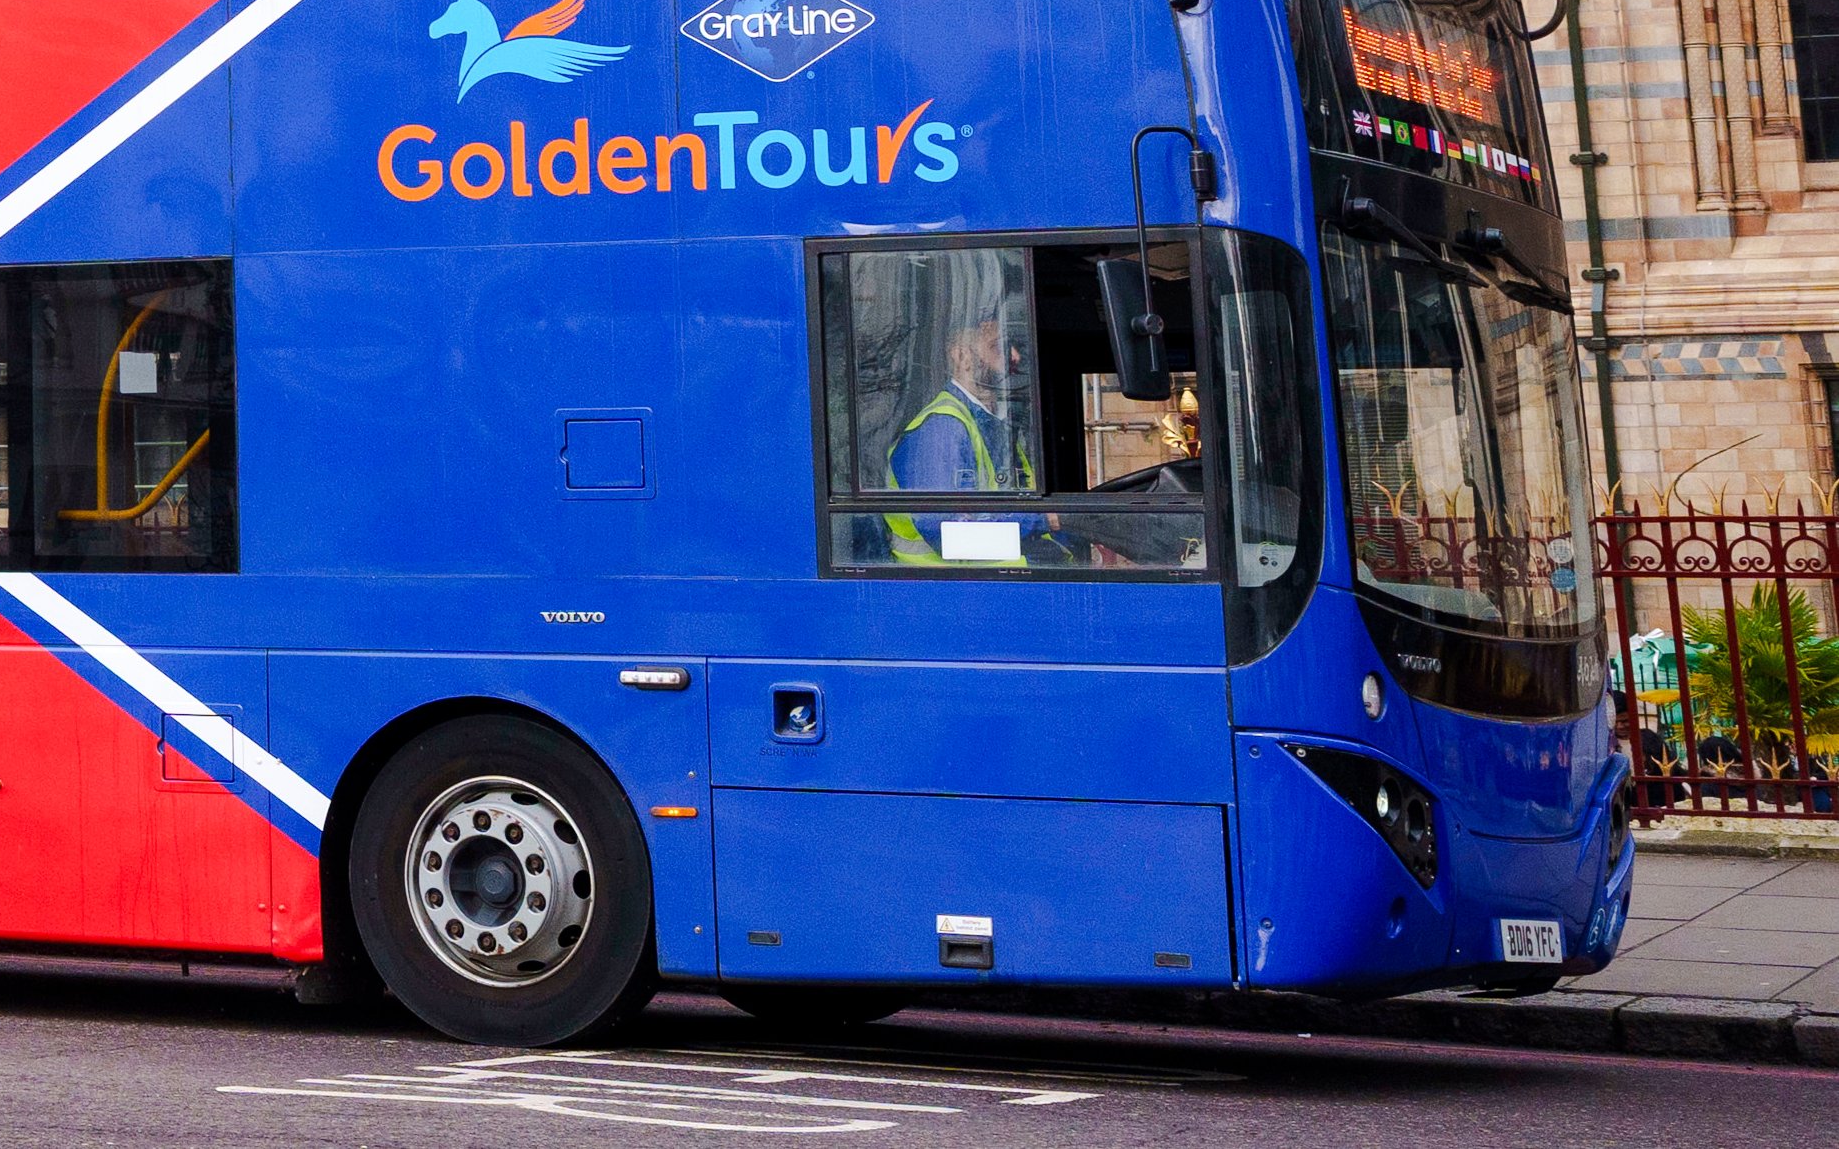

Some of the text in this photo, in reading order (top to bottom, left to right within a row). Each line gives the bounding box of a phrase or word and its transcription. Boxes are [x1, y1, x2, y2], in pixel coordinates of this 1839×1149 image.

[699, 4, 856, 41] Gray Line
[540, 611, 606, 623] VOLVO
[1507, 925, 1556, 957] BD16 YFC
